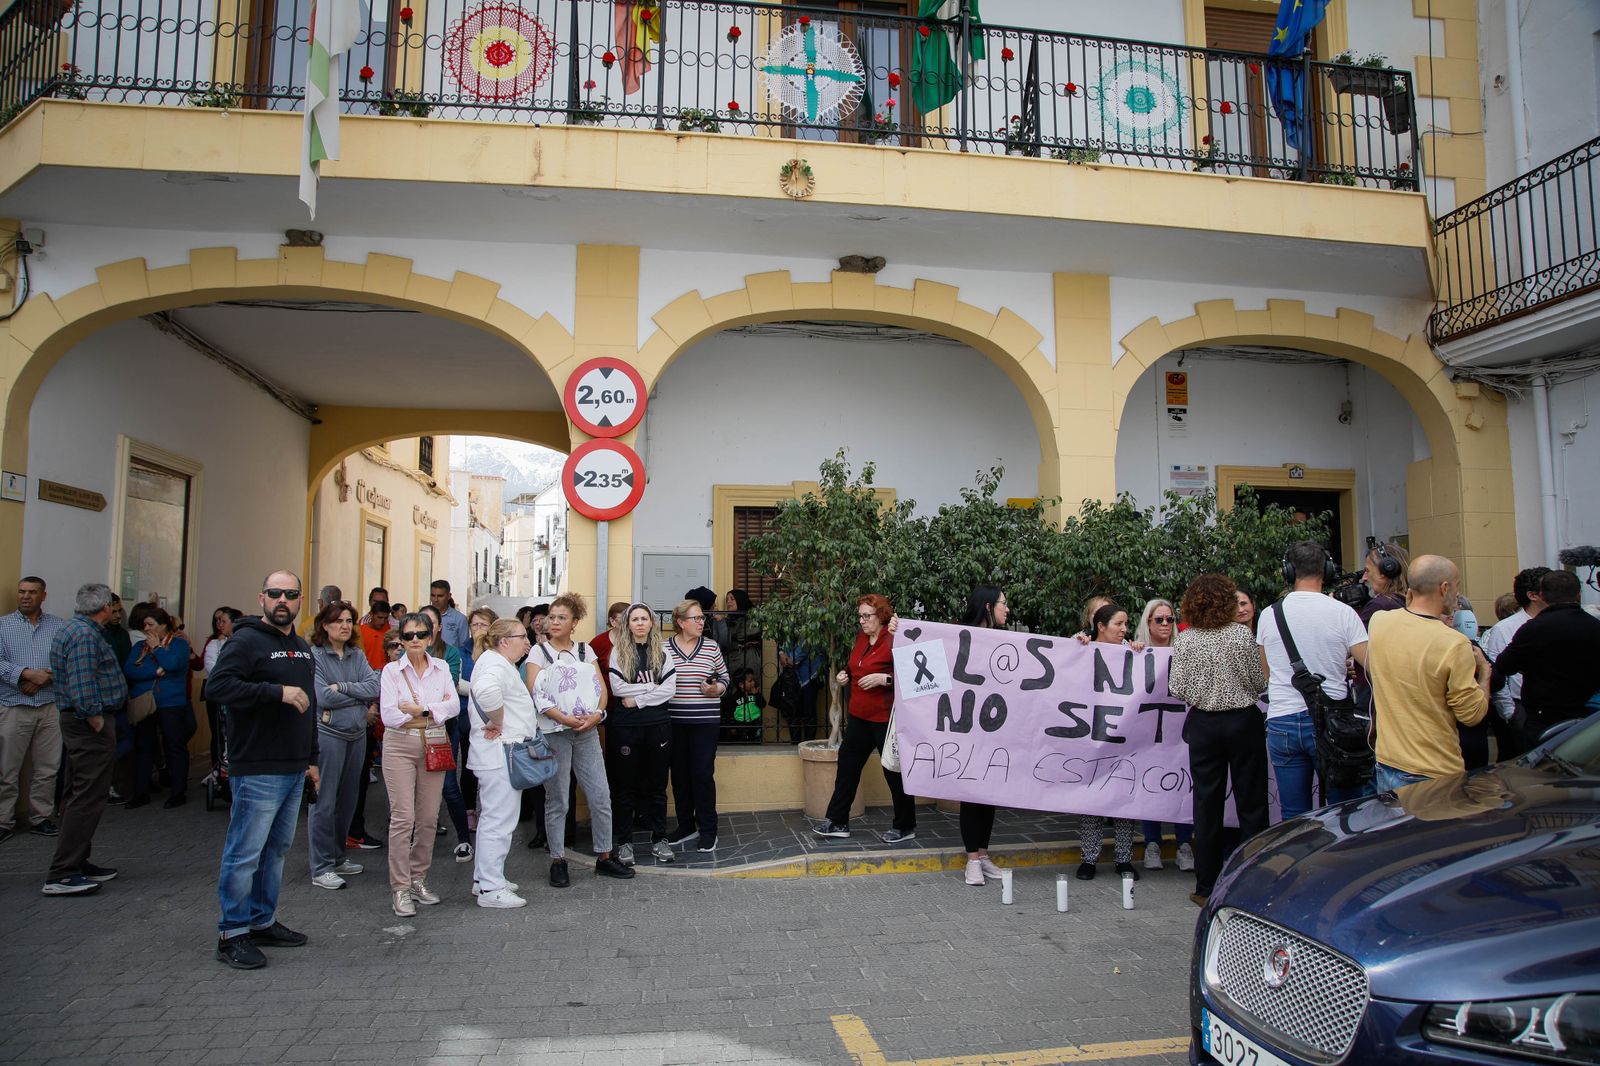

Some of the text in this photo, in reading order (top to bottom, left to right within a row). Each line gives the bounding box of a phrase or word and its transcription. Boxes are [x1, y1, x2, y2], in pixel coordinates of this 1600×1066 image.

[952, 628, 1055, 691] L@S
[935, 688, 1008, 734] NO
[907, 742, 1010, 782] ABLA
